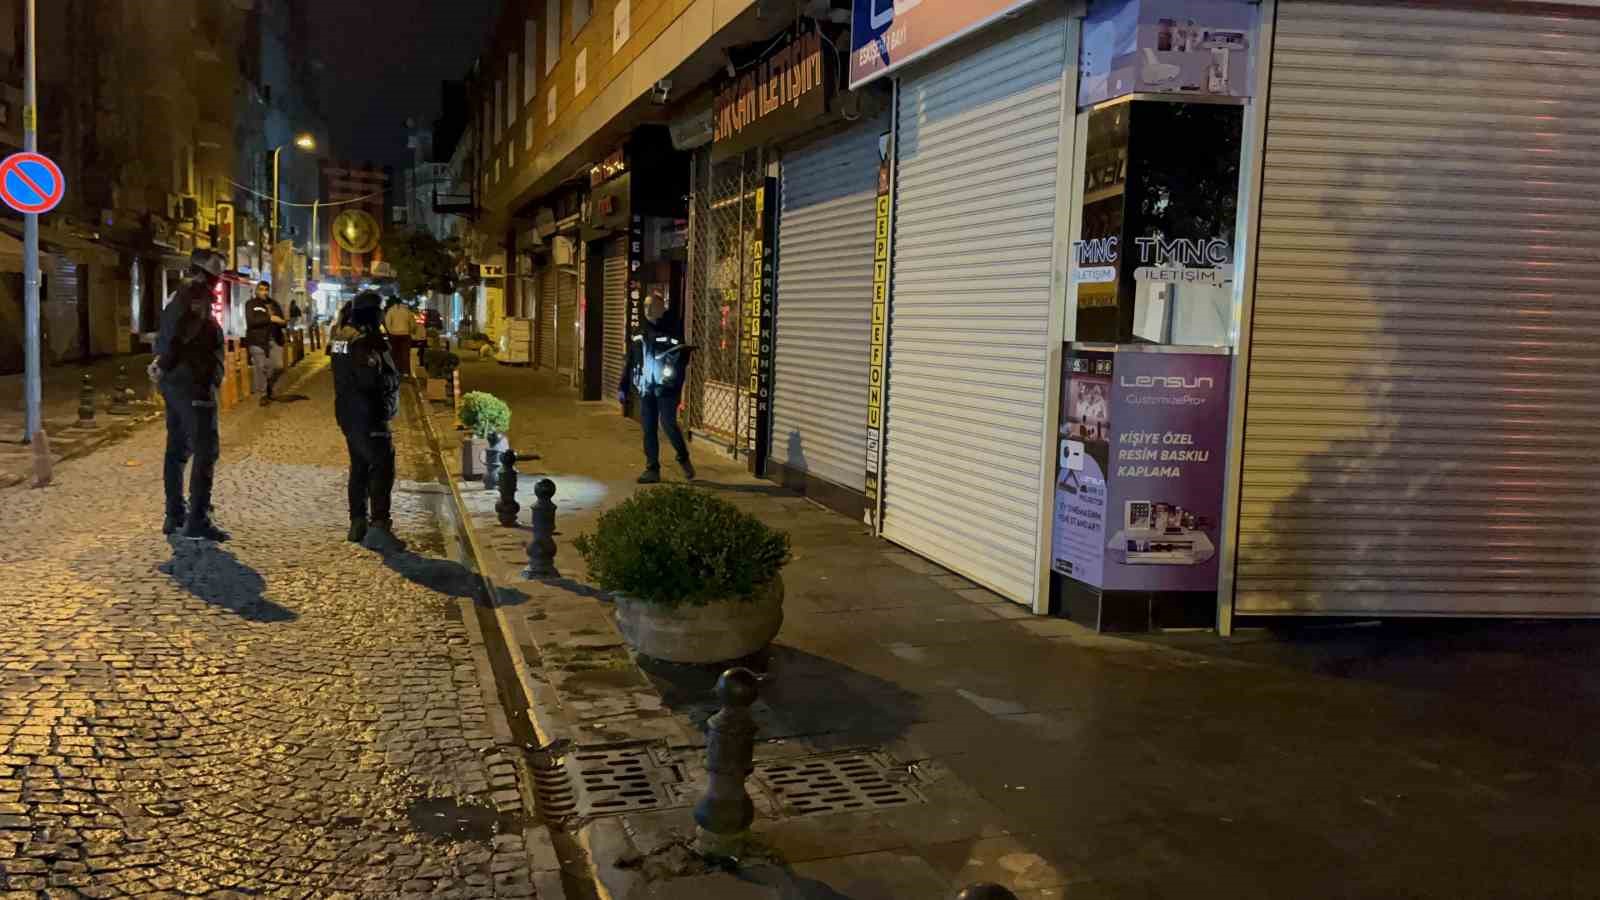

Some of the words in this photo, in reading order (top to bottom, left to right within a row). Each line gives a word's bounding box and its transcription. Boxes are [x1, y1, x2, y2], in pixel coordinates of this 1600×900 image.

[1073, 236, 1118, 264] TMNC
[1134, 237, 1229, 265] TMNC
[1119, 431, 1161, 446] KİŞİYE
[1163, 430, 1195, 445] ÖZEL
[1118, 447, 1158, 462] RESİM
[1117, 465, 1181, 478] KAPLAMA
